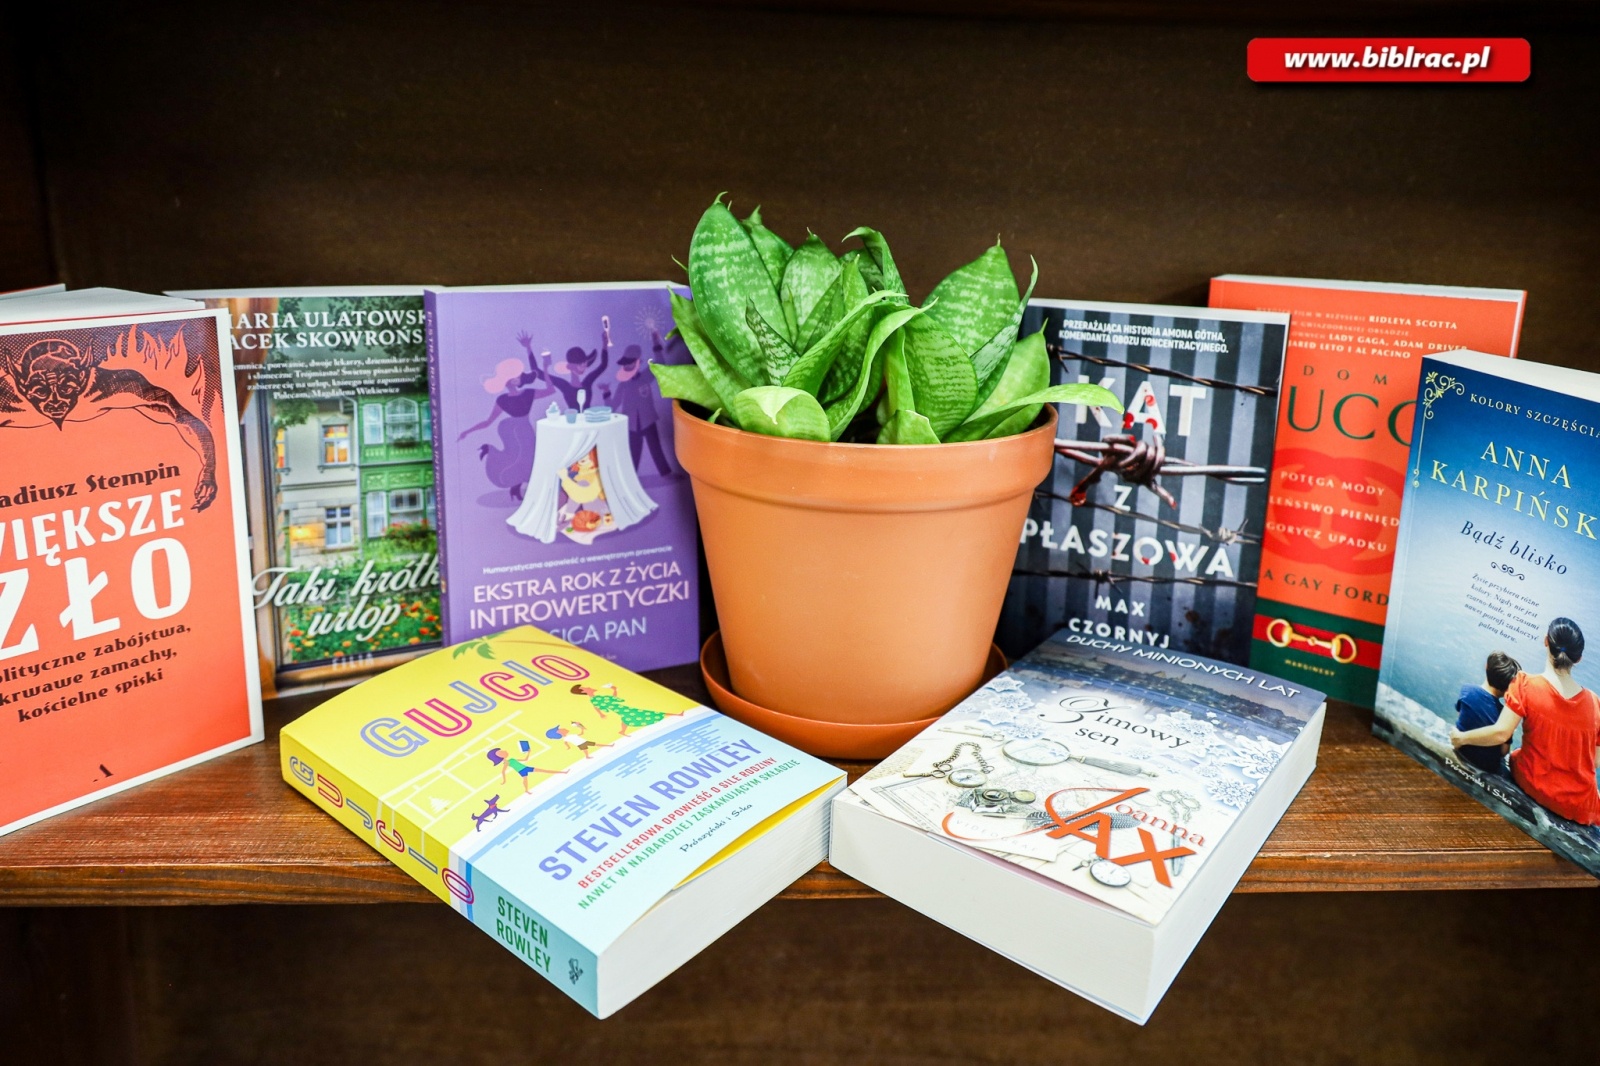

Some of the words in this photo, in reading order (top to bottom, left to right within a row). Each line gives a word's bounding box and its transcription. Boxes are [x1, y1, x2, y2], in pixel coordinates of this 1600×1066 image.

[230, 311, 299, 329] ARIA
[295, 325, 424, 348] SKOWROŃS
[1063, 319, 1122, 333] PRZERAŻAJĄCA
[1123, 324, 1160, 336] HISTORIA
[1162, 328, 1192, 339] AMONA
[1329, 333, 1354, 342] LADY
[1357, 337, 1389, 346] GAGA,
[1393, 339, 1423, 349] ADAM
[1369, 315, 1411, 326] RIDLEYA
[1416, 319, 1457, 329] SCOTTA
[1058, 330, 1111, 343] KOMENDANTA
[1112, 334, 1139, 345] OBOZU
[1140, 337, 1229, 353] KONCENTRACYJNEGO.
[1320, 343, 1344, 352] LETO
[1371, 347, 1411, 359] PACINO
[1075, 374, 1206, 436] KAT
[1470, 393, 1521, 415] KOLORY
[86, 462, 180, 492] Stempin
[1280, 470, 1335, 489] POTĘGA
[1341, 481, 1385, 497] MODY
[1480, 441, 1572, 489] ANNA
[1114, 484, 1133, 511] Z
[1430, 459, 1597, 540] KARPIŃSK
[1020, 517, 1233, 577] PŁASZOWA
[1266, 521, 1321, 540] GORYCZ
[1328, 533, 1386, 552] UPADKU
[1460, 520, 1506, 550] Bądź
[1509, 540, 1567, 575] blisko
[0, 538, 191, 660] ZŁO
[252, 566, 339, 609] Taki
[474, 577, 556, 603] EKSTRA
[561, 570, 605, 592] ROK
[610, 569, 621, 586] Z
[625, 561, 681, 583] ŻYCIA
[1284, 573, 1322, 591] GAY
[307, 595, 401, 641] urlop
[470, 580, 690, 629] INTROWERTYCZKI
[1095, 595, 1146, 617] MAX
[94, 624, 191, 657] zabójstwa,
[604, 616, 647, 640] PAN
[1068, 617, 1170, 649] CZORNYJ
[0, 674, 83, 707] krwawe
[90, 648, 177, 680] zamachy,
[331, 653, 374, 670] FILIA
[1066, 634, 1133, 654] DUCHY
[1133, 649, 1257, 685] MINIONYCH
[1258, 679, 1301, 698] LAT
[18, 688, 108, 722] kościelne
[115, 668, 163, 693] spiski
[360, 655, 590, 757] GUJCIO
[1038, 696, 1191, 749] Zimowy
[1075, 725, 1119, 748] sen
[1445, 757, 1485, 788] Prószyński
[289, 756, 475, 905] GUJCIO
[539, 794, 661, 881] STEVEN
[649, 738, 762, 800] ROWLEY
[577, 824, 664, 889] BESTSELLEROWA
[661, 790, 713, 826] OPOWIEŚĆ
[711, 785, 720, 795] O
[718, 775, 742, 790] SILE
[739, 757, 777, 778] RODZINY
[577, 875, 618, 909] NAWET
[615, 865, 629, 878] W
[627, 819, 694, 868] NAJBARDZIEJ
[691, 774, 762, 827] ZASKAKUJĄCYM
[759, 758, 800, 782] SKŁADZIE
[680, 820, 726, 852] Prószyński
[1046, 812, 1197, 888] AX
[497, 896, 548, 948] STEVEN
[496, 918, 551, 973] ROWLEY
